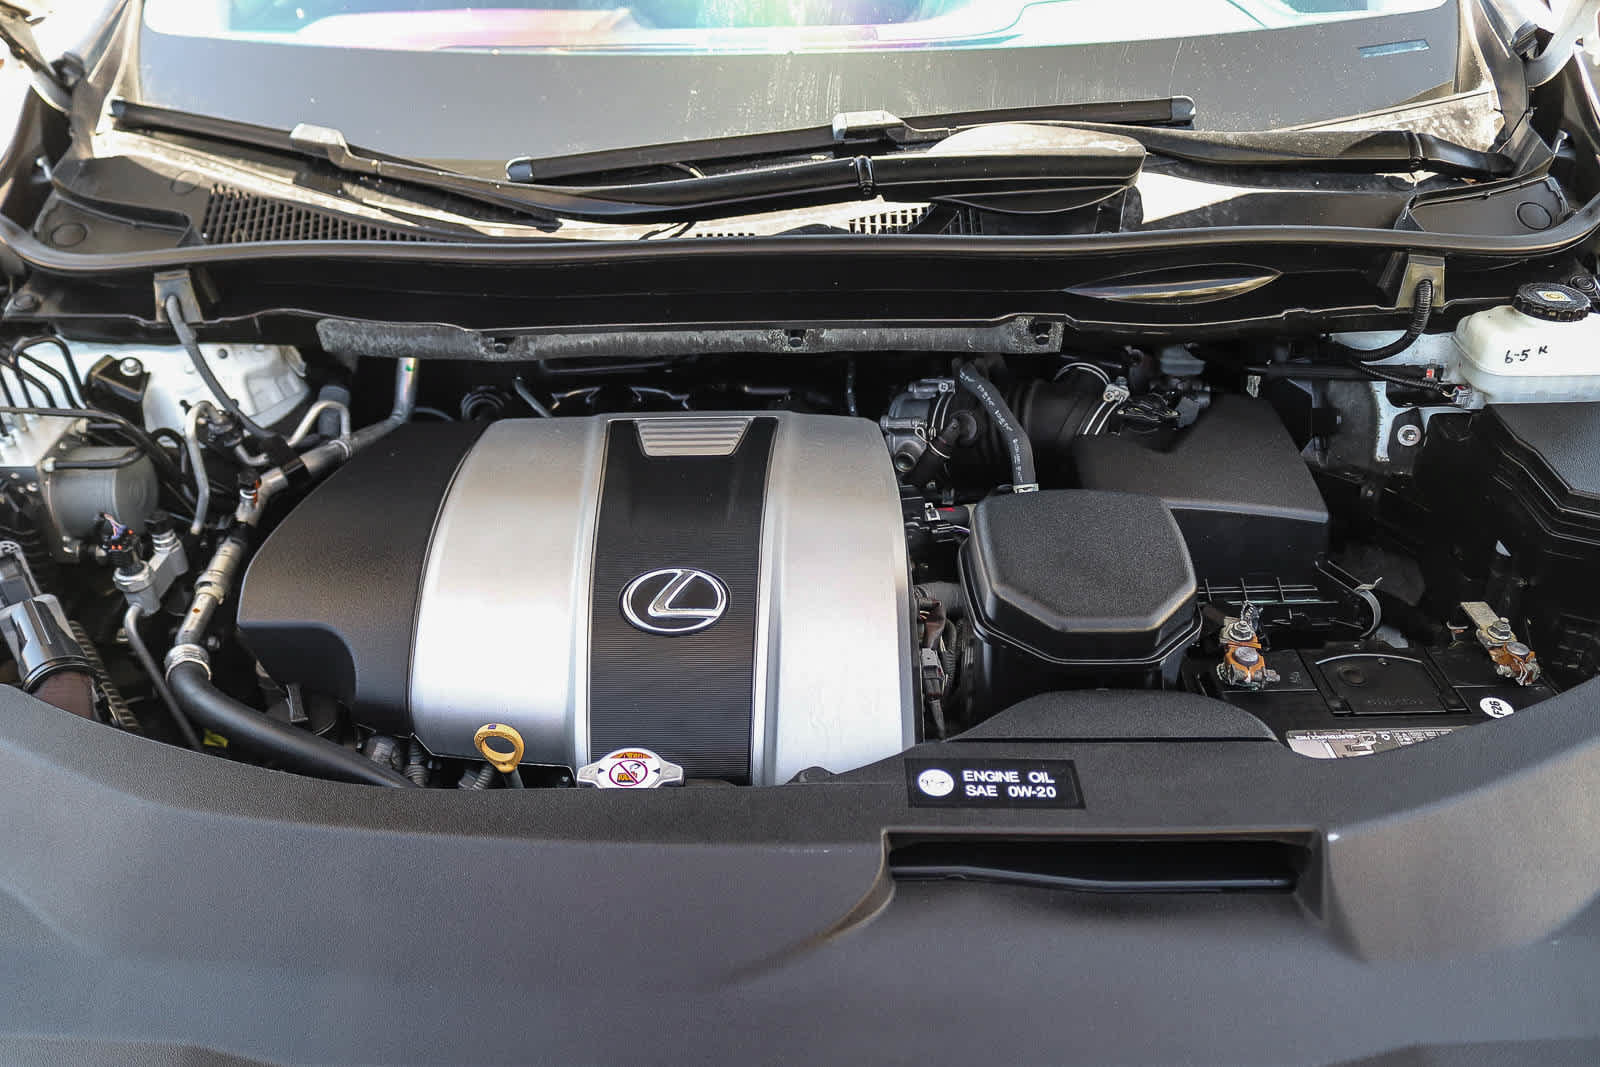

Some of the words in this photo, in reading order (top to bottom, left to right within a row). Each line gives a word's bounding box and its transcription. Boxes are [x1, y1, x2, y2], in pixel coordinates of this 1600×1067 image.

[962, 770, 1020, 783] ENGINE
[1028, 771, 1056, 784] OIL
[965, 784, 999, 797] SAE
[1007, 785, 1057, 798] 0W-20
